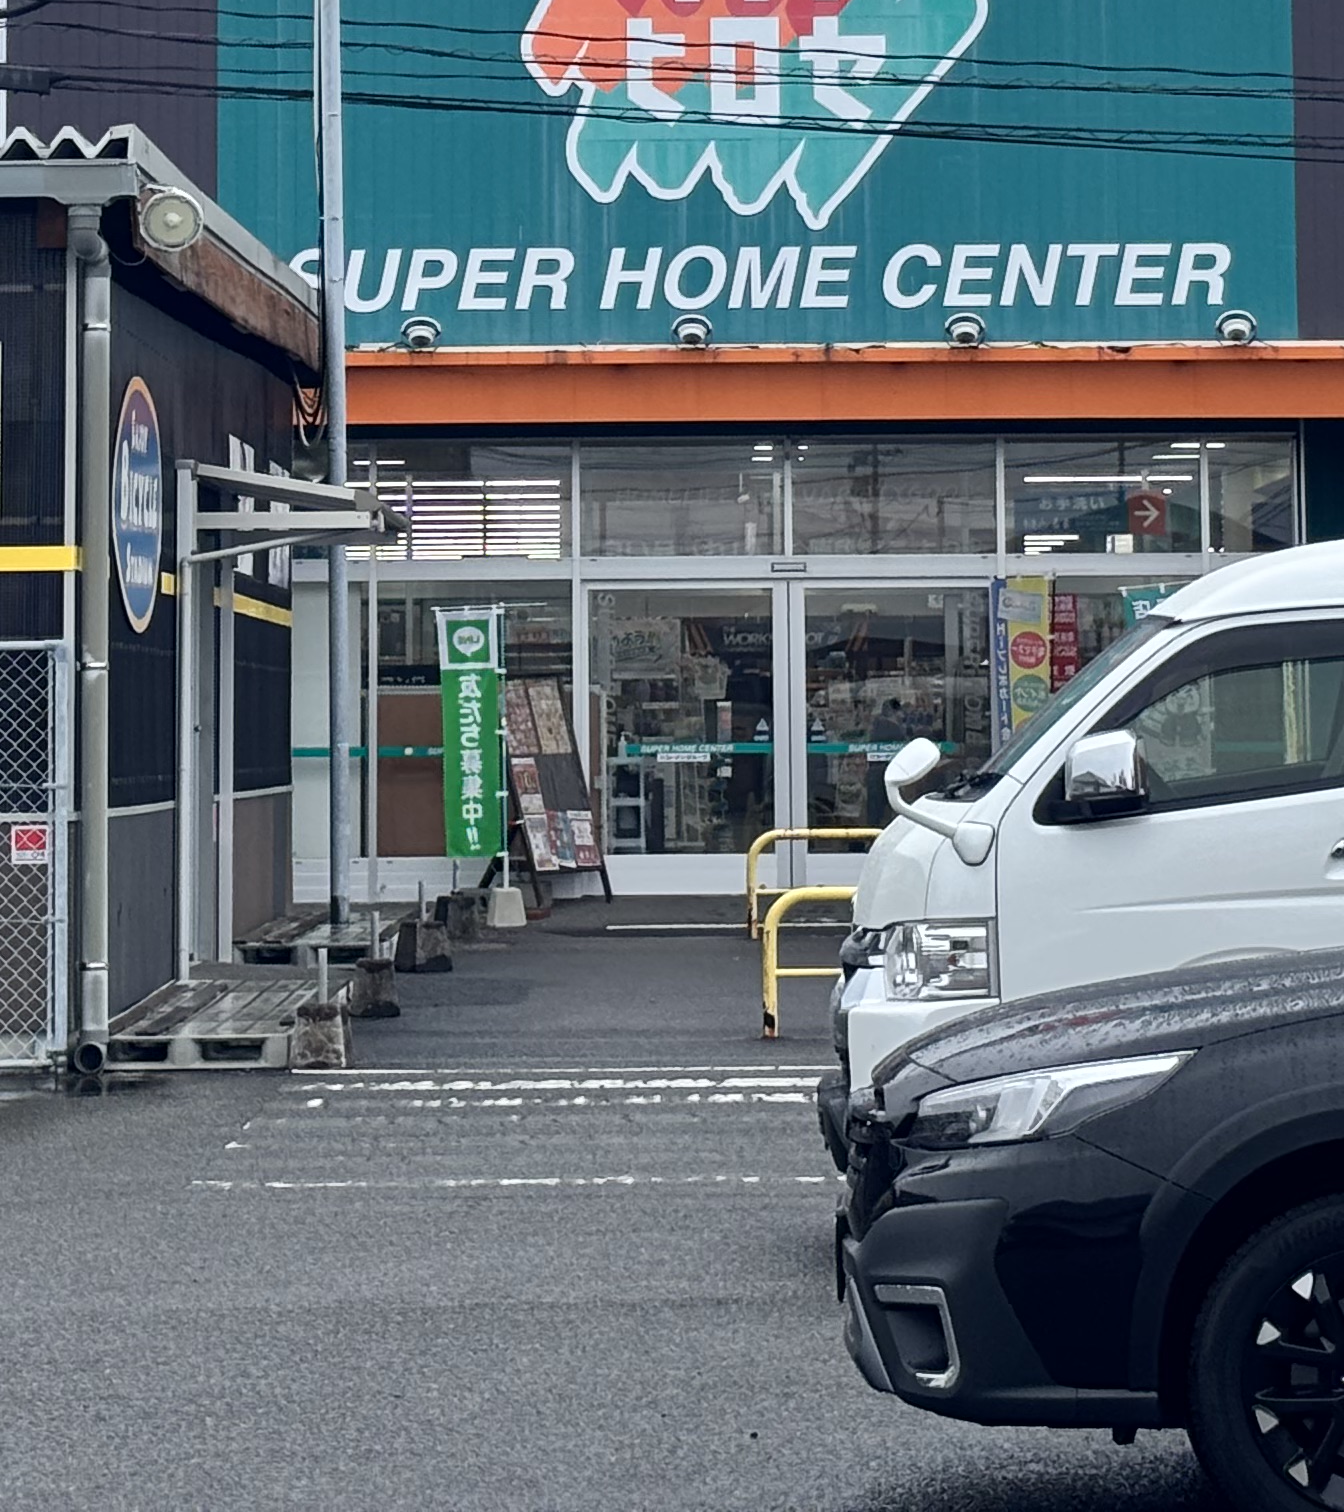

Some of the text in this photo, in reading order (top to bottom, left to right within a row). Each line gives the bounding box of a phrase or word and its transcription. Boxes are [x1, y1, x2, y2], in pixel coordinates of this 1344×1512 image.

[624, 16, 887, 125] ヒロセ
[601, 244, 857, 312] HOME
[881, 241, 1233, 308] CENTER
[640, 743, 734, 753] SUPER HOME CENTER
